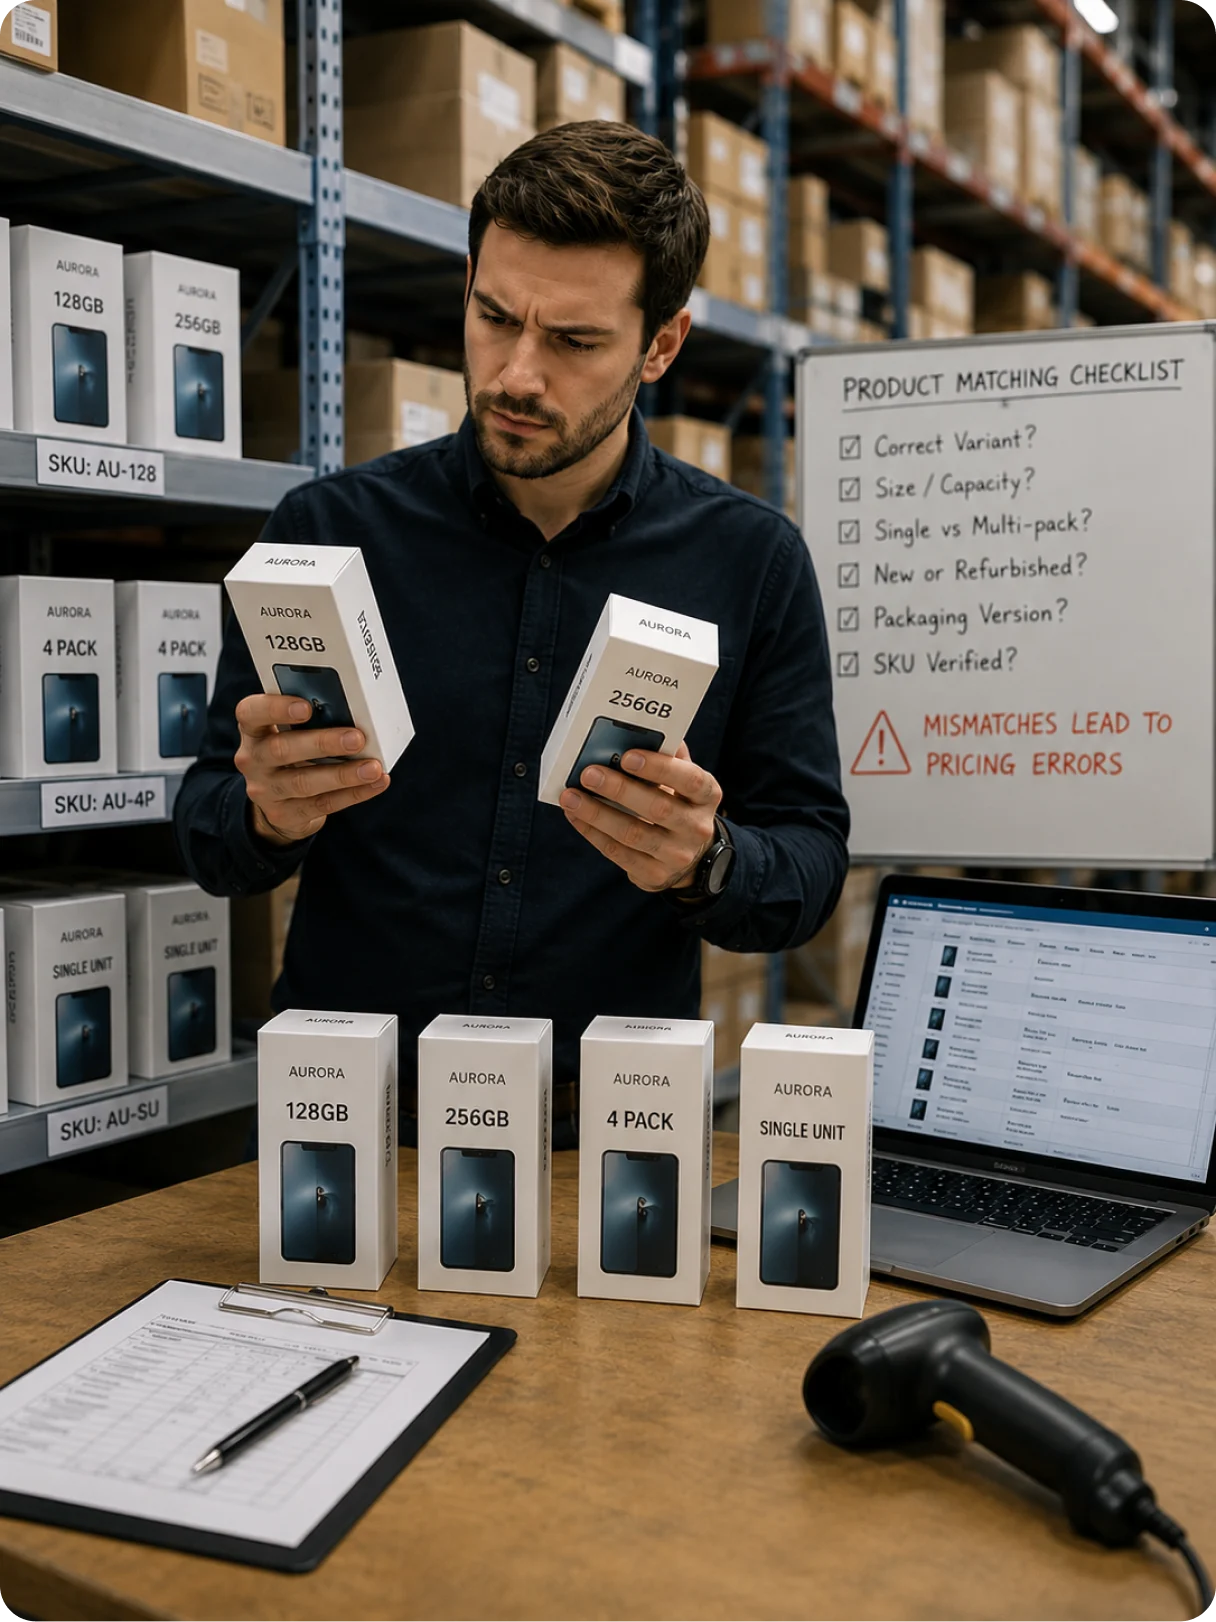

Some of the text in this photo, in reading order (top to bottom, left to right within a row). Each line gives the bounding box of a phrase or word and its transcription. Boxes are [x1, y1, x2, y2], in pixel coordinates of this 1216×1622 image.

[56, 260, 100, 278] AURORA
[55, 291, 104, 315] 128GB
[175, 313, 222, 336] 256GB
[843, 358, 1185, 402] PRODUCT MATCHING CHECKLIST
[875, 424, 1037, 458] Correct Variant?
[49, 454, 157, 483] SKU: AU-128
[876, 467, 1036, 501] Size / Capacity?
[875, 508, 1093, 549] Single vs Multi-pack?
[265, 558, 316, 567] AURORA
[875, 552, 1088, 584] New or Refurbished?
[47, 606, 92, 619] AURORA
[261, 607, 313, 619] AURORA
[875, 598, 1069, 636] Packaging Version?
[638, 619, 692, 640] AURORA
[42, 639, 98, 657] 4 PACK
[157, 641, 207, 658] 4 PACK
[265, 635, 326, 653] 128GB
[874, 646, 1018, 676] SKU Verified?
[625, 667, 679, 689] AURORA
[608, 689, 673, 719] 256GB
[924, 712, 1173, 738] MISMATCHES LEAD TO
[927, 752, 1123, 777] PRICING ERRORS
[55, 790, 156, 815] SKU: AU-4P
[61, 927, 104, 943] AURORA
[164, 938, 219, 960] SINGLE UNIT
[53, 956, 114, 979] SINGLE UNIT
[289, 1066, 346, 1080] AURORA
[449, 1072, 506, 1086] AURORA
[613, 1073, 671, 1088] AURORA
[774, 1083, 833, 1098] AURORA
[60, 1100, 160, 1141] SKU: AU-SU
[286, 1102, 349, 1122] 128GB
[446, 1108, 510, 1128] 256GB
[606, 1111, 674, 1131] 4 PACK
[760, 1121, 846, 1141] SINGLE UNIT
